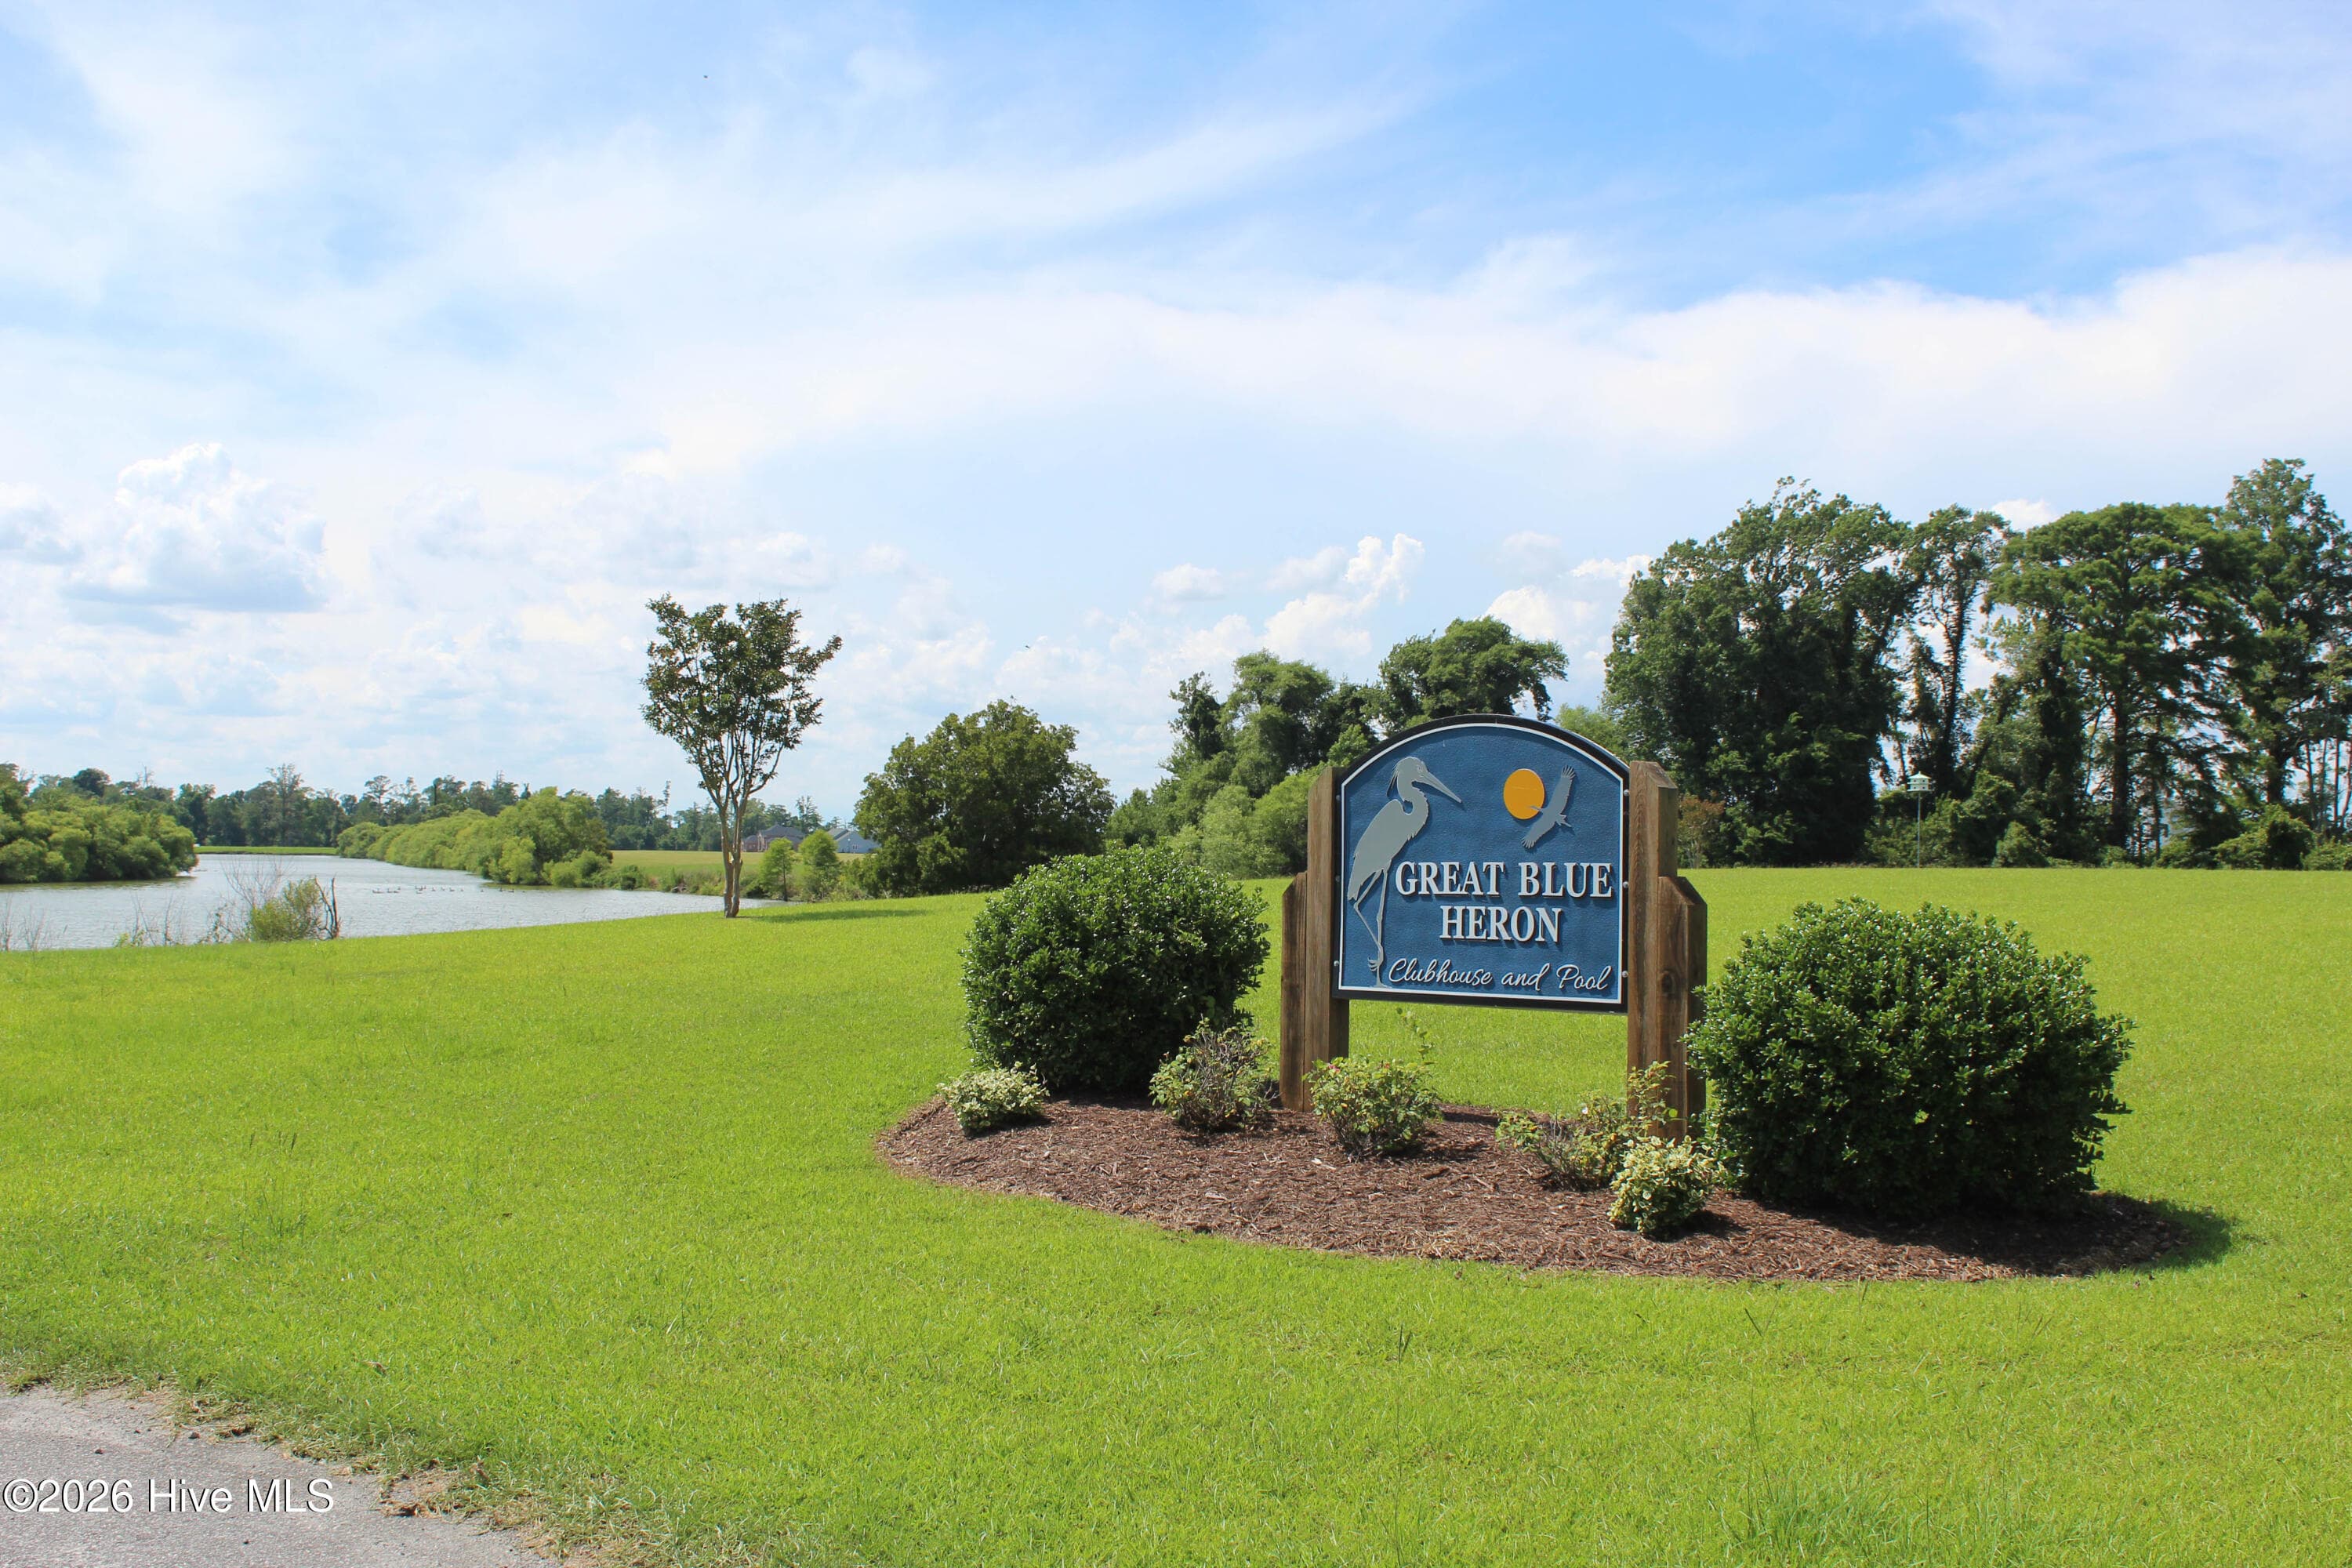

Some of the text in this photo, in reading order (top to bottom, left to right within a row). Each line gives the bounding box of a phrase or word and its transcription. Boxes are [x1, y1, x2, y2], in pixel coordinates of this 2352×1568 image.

[1396, 861, 1613, 898] GREAT BLUE
[1439, 905, 1563, 943] HERON
[1388, 957, 1612, 991] Clubhouse and Pool
